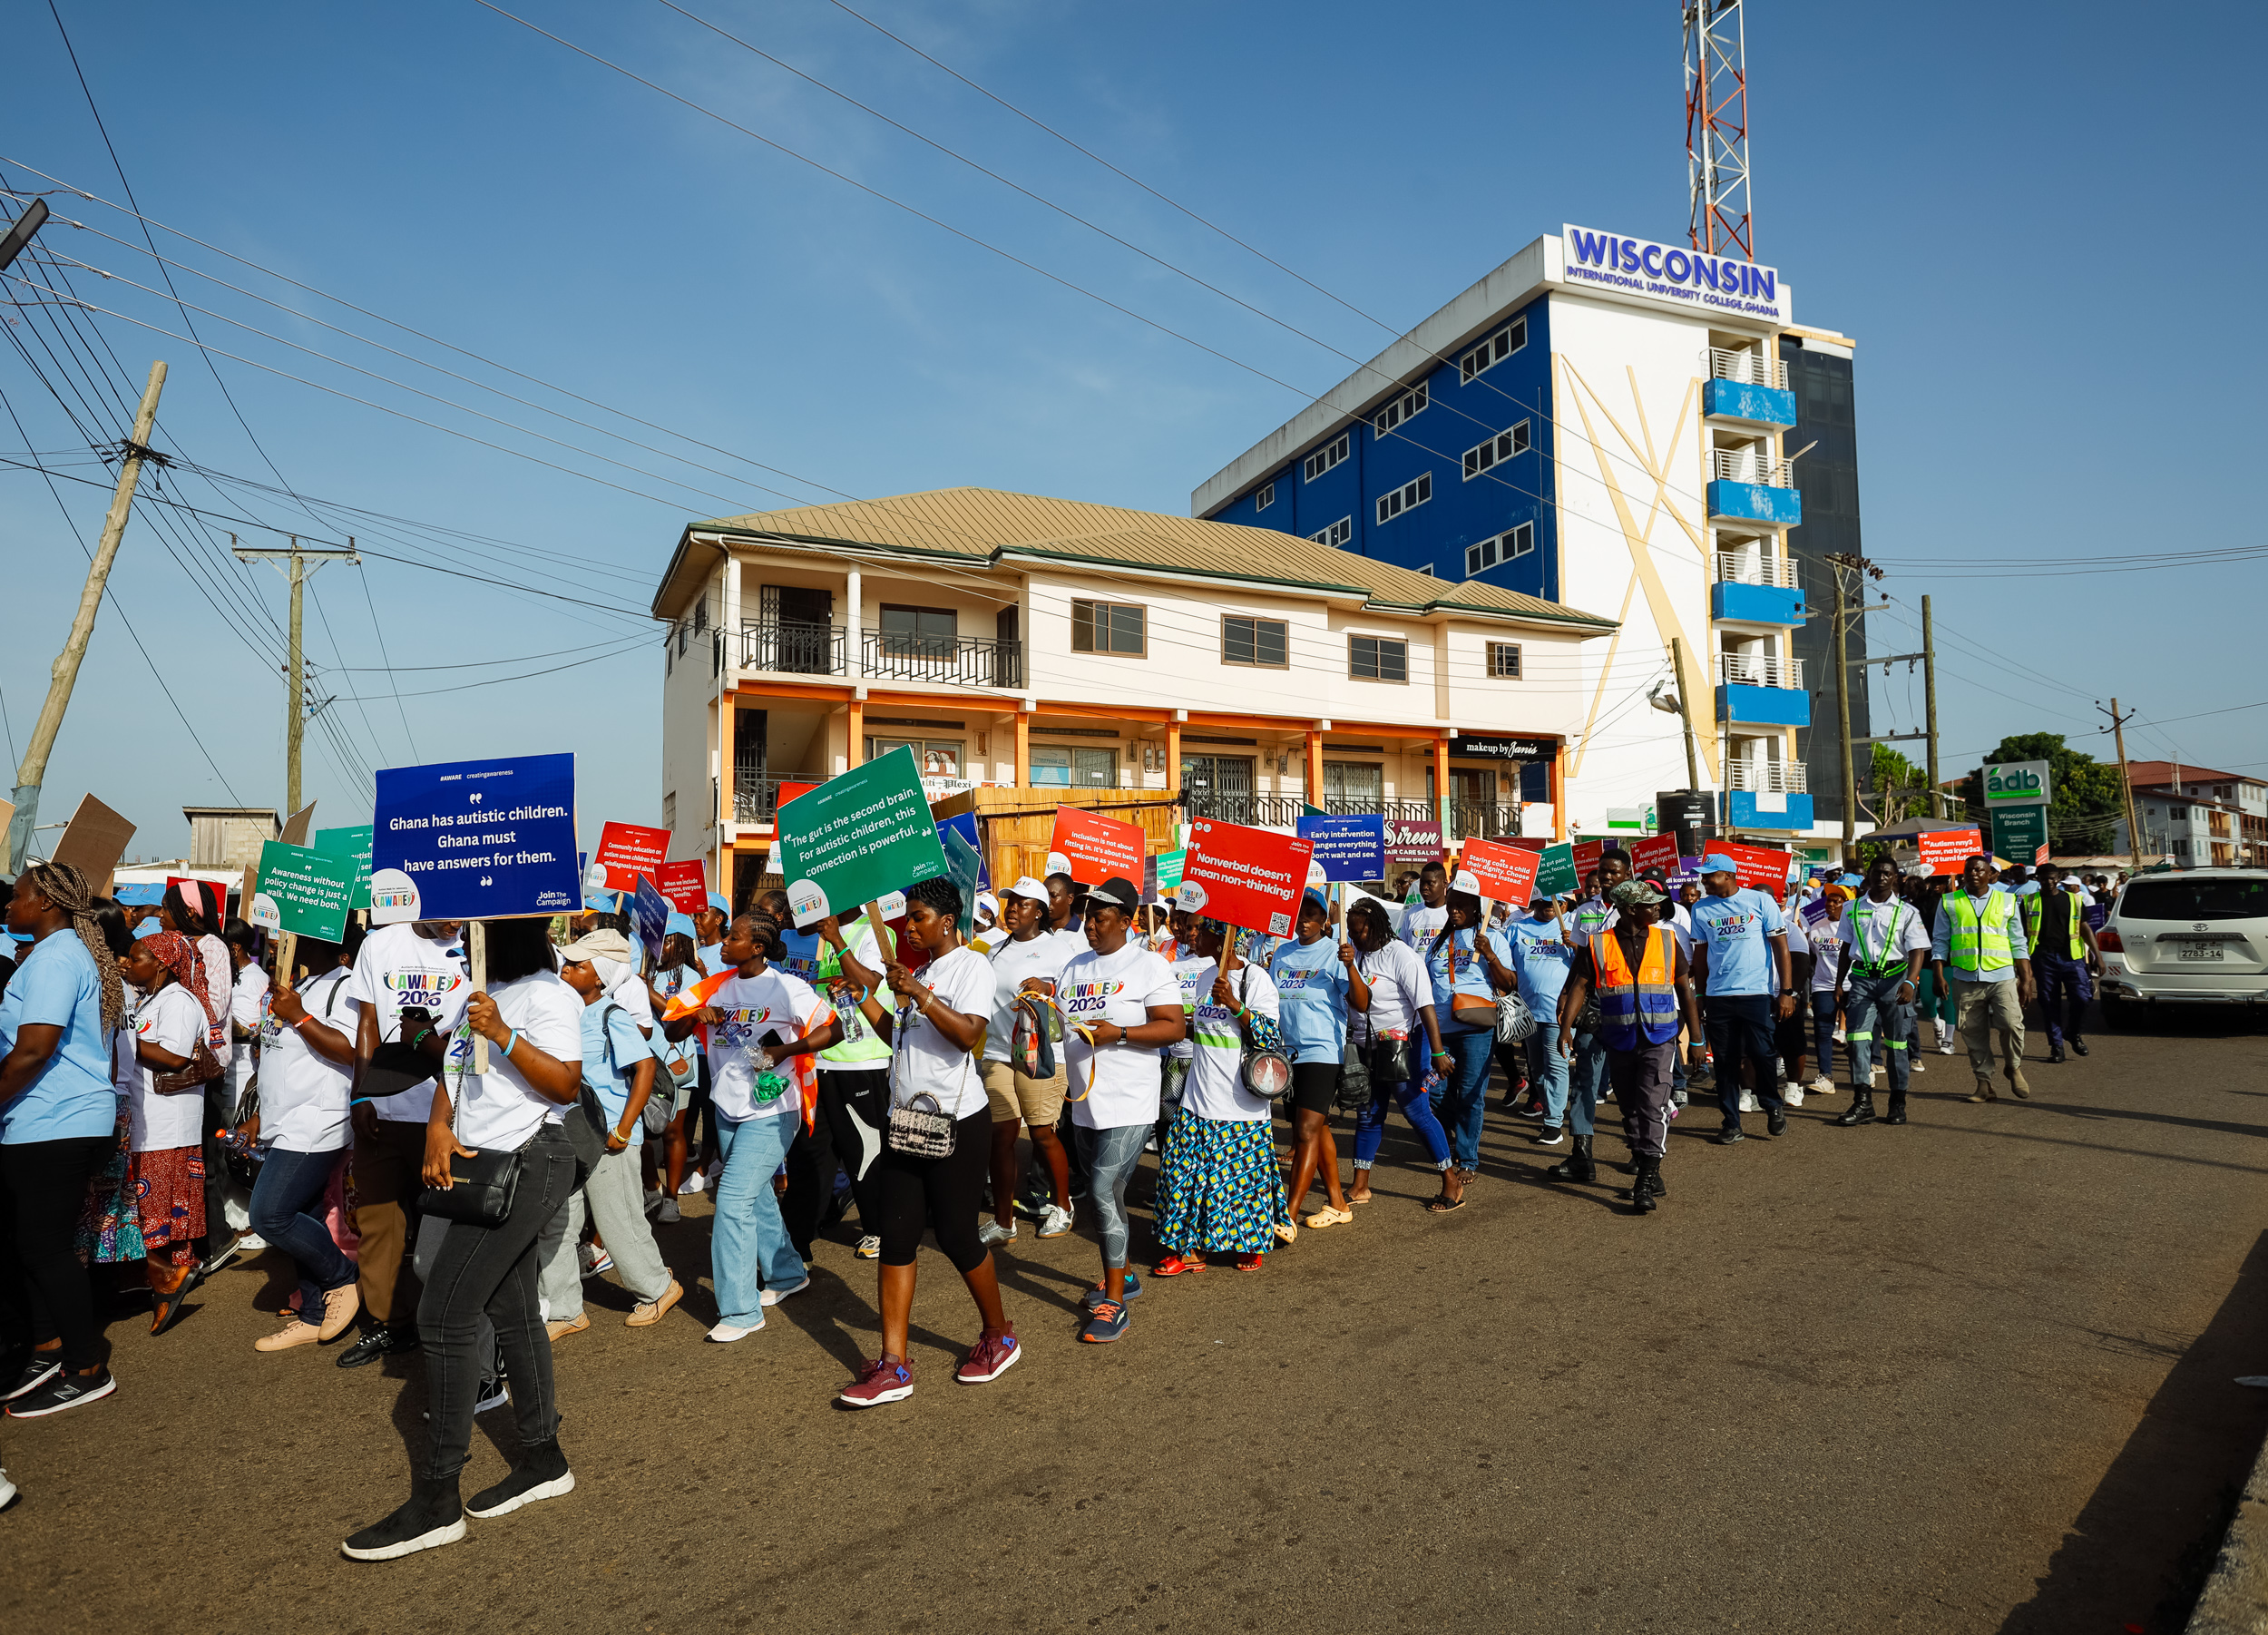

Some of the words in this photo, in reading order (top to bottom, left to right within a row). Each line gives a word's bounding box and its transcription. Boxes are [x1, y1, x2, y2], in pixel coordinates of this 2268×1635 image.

[1569, 229, 1774, 302] WISCONSIN
[1566, 265, 1645, 290] INTERNATIONAL
[1647, 281, 1701, 301] UNIVERSITY
[1466, 741, 1499, 755] makeup
[1499, 743, 1508, 754] by
[1507, 740, 1538, 759] Janis
[440, 773, 462, 782] #AWARE
[466, 769, 513, 780] creatingawareness
[389, 817, 429, 831] Ghana
[432, 814, 454, 827] has
[456, 808, 506, 826] autistic
[508, 805, 568, 820] children.
[791, 834, 807, 848] The
[808, 827, 824, 843] gut
[824, 823, 833, 833] is
[833, 816, 849, 829] the
[850, 802, 885, 822] second
[887, 788, 917, 806] brain.
[437, 835, 480, 848] Ghana
[483, 830, 516, 845] must
[798, 848, 814, 862] For
[816, 834, 850, 856] autistic
[851, 816, 895, 840] children,
[894, 806, 916, 821] this
[1071, 831, 1100, 844] Inclusion
[1106, 838, 1117, 847] not
[1117, 841, 1134, 852] about
[1310, 830, 1330, 840] Early
[1330, 829, 1375, 838] intervention
[1383, 820, 1440, 848] Sireen
[608, 842, 633, 852] Community
[633, 847, 655, 855] education
[806, 847, 858, 877] connection
[858, 845, 868, 856] is
[869, 824, 918, 854] powerful.
[1064, 839, 1084, 851] fitting
[1084, 841, 1093, 851] in.
[1104, 848, 1122, 858] about
[1122, 851, 1139, 863] being
[1288, 846, 1310, 854] Campaign
[1338, 840, 1379, 849] everything.
[1955, 839, 1973, 847] nny3
[631, 854, 650, 862] children
[1070, 850, 1099, 863] welcome
[1107, 858, 1119, 868] you
[1119, 861, 1130, 870] are.
[1347, 850, 1361, 858] and
[1639, 848, 1658, 859] Autism
[404, 859, 435, 873] have
[437, 856, 491, 870] answers
[494, 852, 513, 866] for
[516, 851, 556, 864] them.
[603, 860, 632, 870] misdiagnosis
[913, 863, 926, 873] Join
[1196, 852, 1250, 874] Nonverbal
[1466, 859, 1482, 868] their
[1482, 864, 1505, 876] dignity.
[1506, 870, 1530, 881] Choose
[1469, 854, 1491, 866] Staring
[1491, 860, 1509, 869] costs
[1514, 865, 1530, 875] child
[1546, 859, 1555, 868] gut
[1555, 857, 1567, 865] pain
[1551, 865, 1567, 873] focus,
[1763, 864, 1782, 872] where
[271, 866, 312, 882] Awareness
[313, 876, 346, 889] without
[912, 864, 940, 878] Campaign
[1470, 866, 1498, 879] kindness
[1498, 873, 1523, 886] instead.
[1753, 869, 1766, 877] seat
[1773, 872, 1784, 880] the
[264, 876, 288, 888] policy
[288, 881, 317, 896] change
[318, 886, 325, 896] is
[324, 888, 341, 900] just
[682, 884, 702, 892] everyone
[1189, 866, 1220, 881] mean
[1220, 873, 1295, 902] non-thinking!
[266, 888, 285, 899] walk.
[286, 892, 298, 902] We
[298, 896, 319, 906] need
[319, 897, 341, 911] both.
[379, 894, 408, 907] AWARE
[536, 897, 571, 906] Campaign
[537, 891, 556, 900] Join
[797, 900, 818, 915] AWARE
[1716, 915, 1745, 927] AWARE
[1716, 925, 1745, 936] 2026
[1530, 945, 1557, 955] 2026
[784, 956, 814, 973] AWARE
[396, 974, 446, 991] AWARE
[1284, 969, 1311, 980] AWARE
[1068, 982, 1110, 998] AWARE
[1279, 979, 1306, 989] 2026
[396, 990, 442, 1007] 2026
[1068, 995, 1106, 1013] 2026
[1198, 1004, 1227, 1021] 2026
